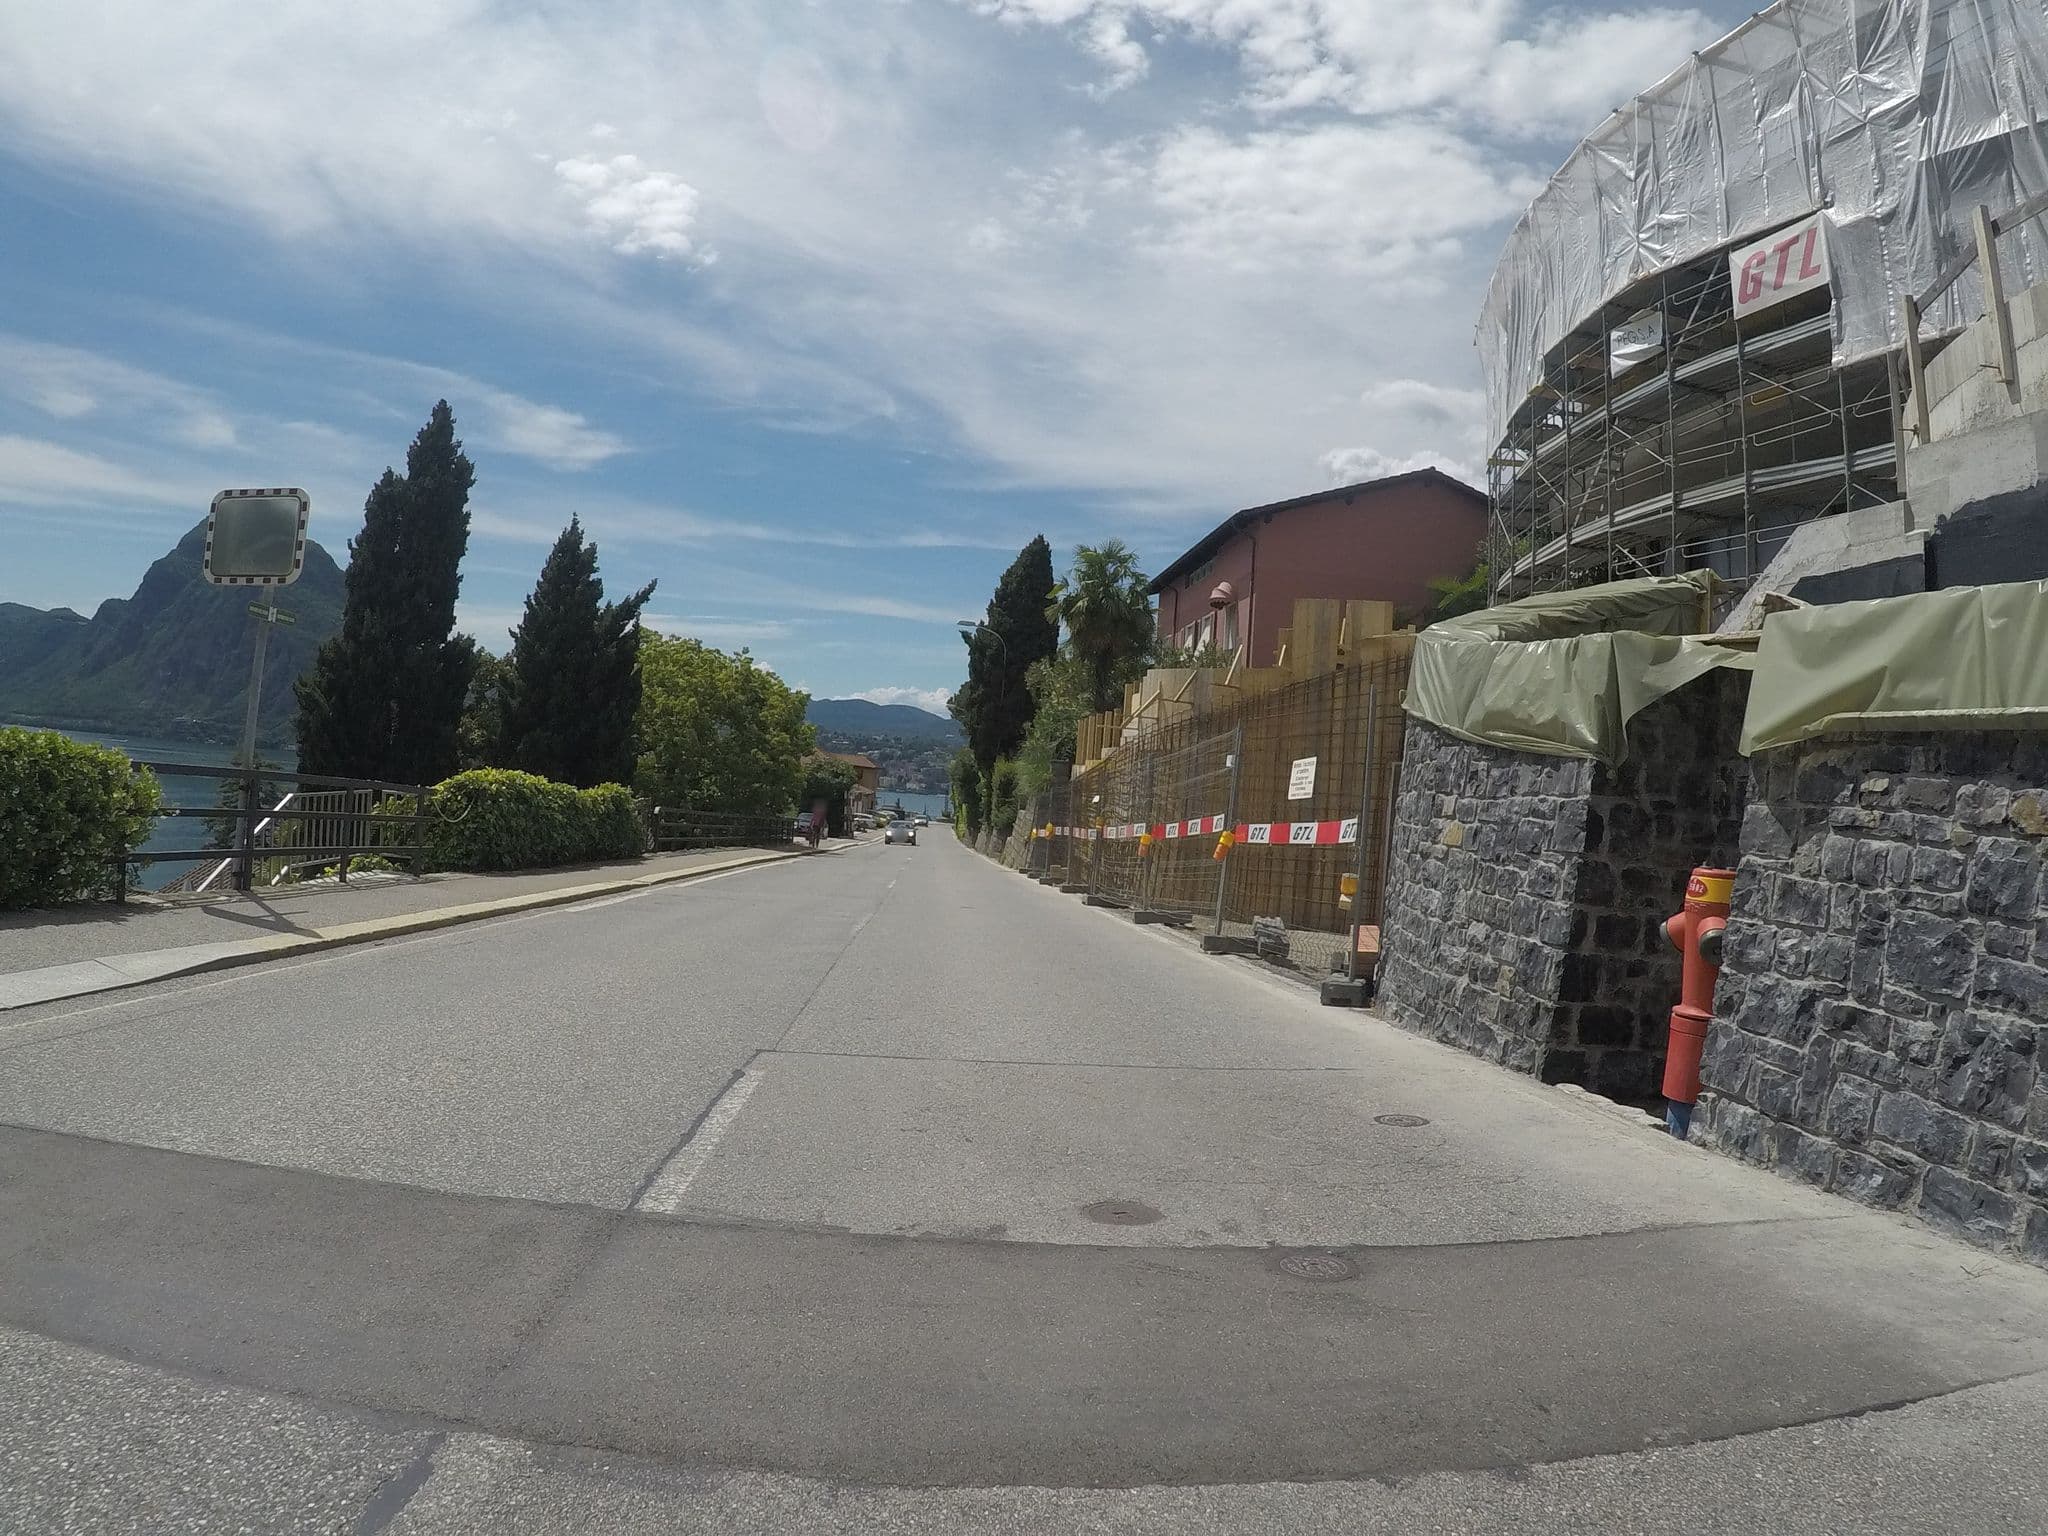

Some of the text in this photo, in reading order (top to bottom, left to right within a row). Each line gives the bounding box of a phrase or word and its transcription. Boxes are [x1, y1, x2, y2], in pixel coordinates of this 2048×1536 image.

[1738, 227, 1821, 304] GTL
[1250, 827, 1267, 840] GTL
[1292, 826, 1314, 840] GTL
